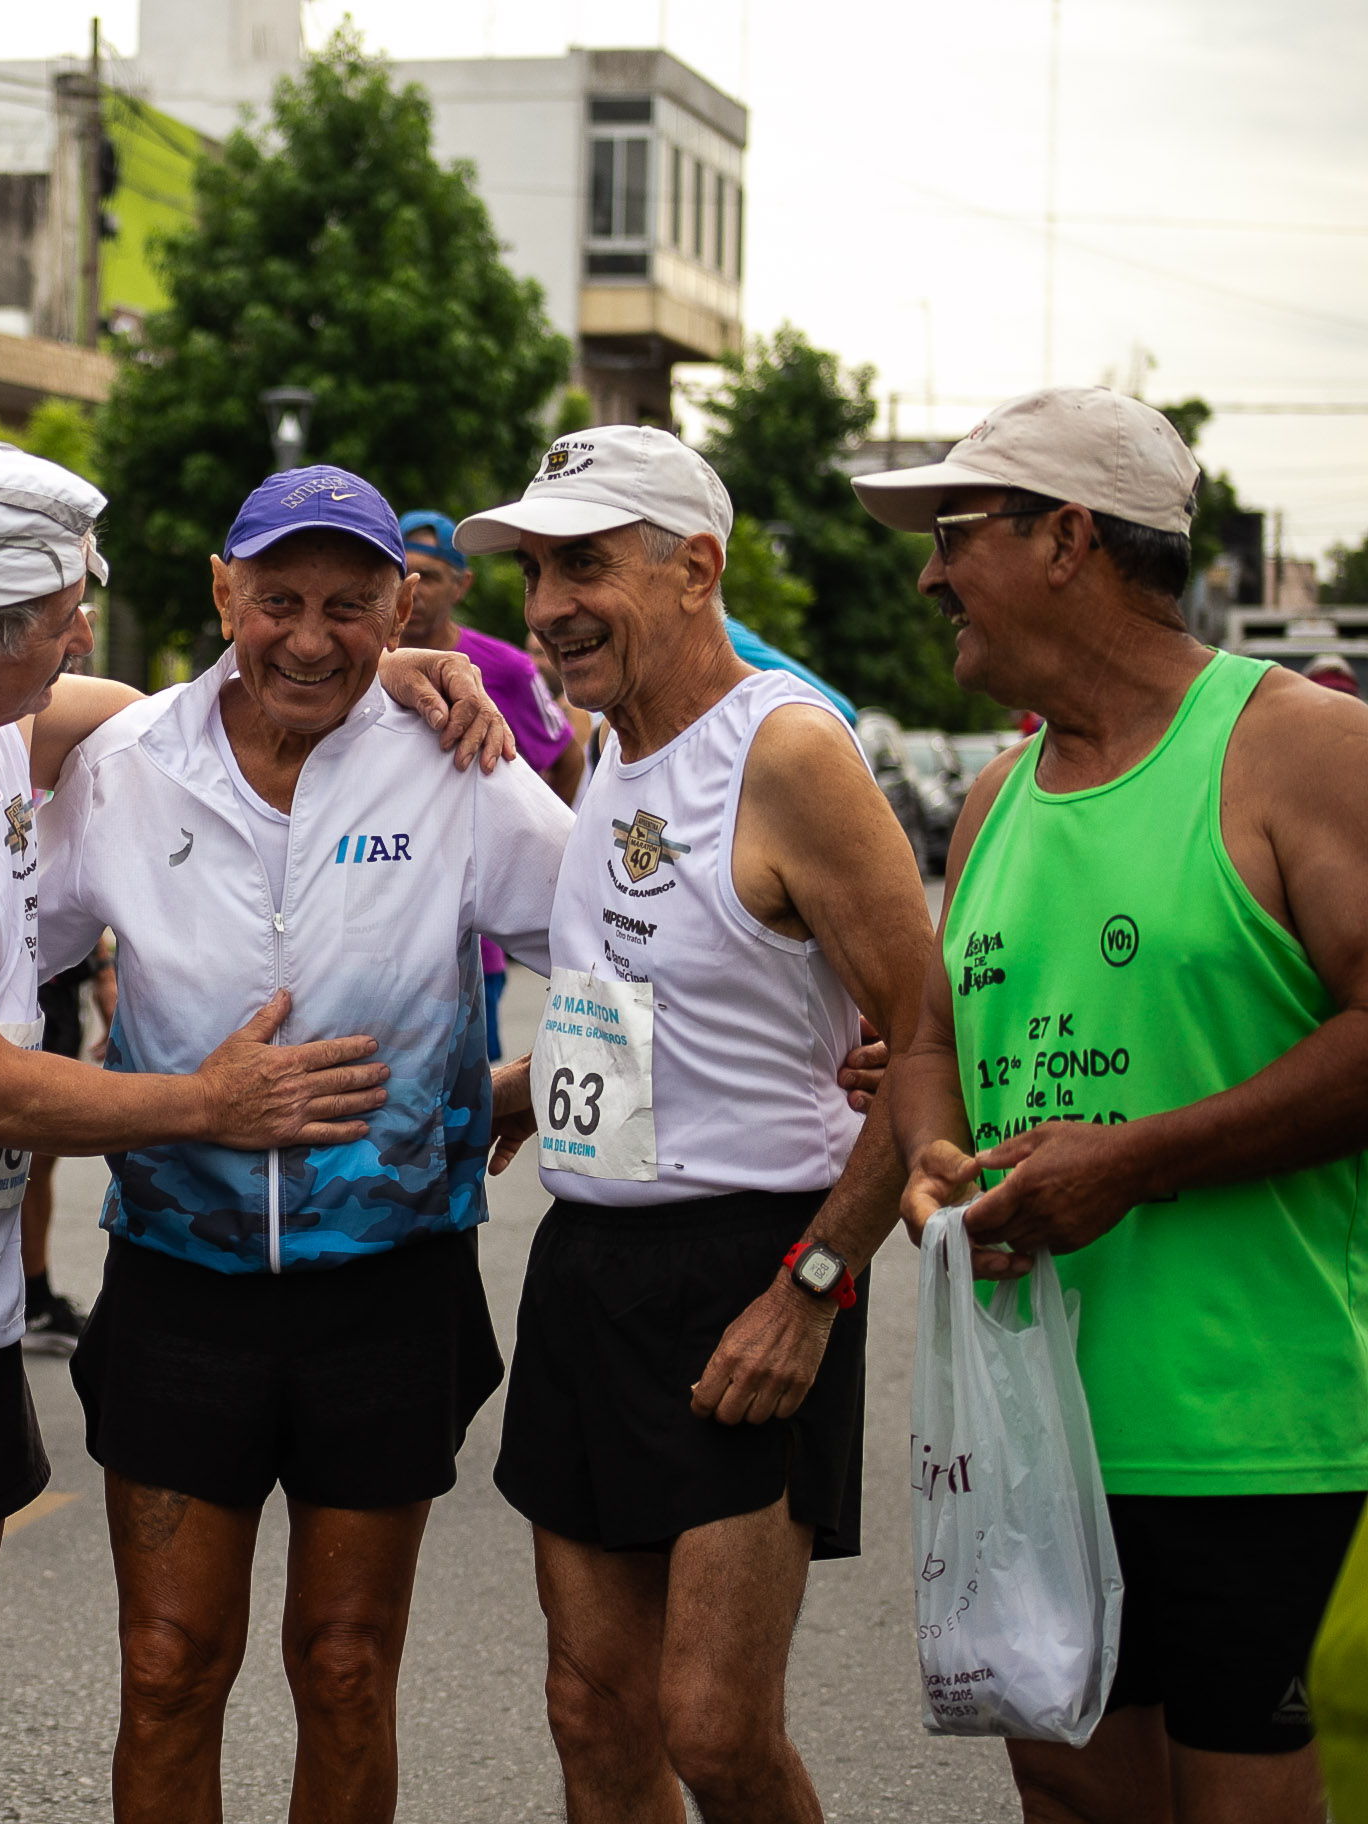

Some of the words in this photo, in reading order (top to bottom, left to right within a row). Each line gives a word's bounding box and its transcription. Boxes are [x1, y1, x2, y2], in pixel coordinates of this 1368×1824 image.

[280, 476, 349, 509] NIKE
[630, 849, 651, 870] 40
[628, 879, 676, 897] GRANEROS
[974, 955, 987, 968] DE
[552, 994, 562, 1011] 40
[1027, 1015, 1051, 1041] 27
[1058, 1013, 1074, 1037] K
[1033, 1047, 1130, 1081] FONDO
[548, 1067, 605, 1136] 63
[1025, 1084, 1047, 1108] de
[1056, 1082, 1074, 1107] la
[543, 1136, 554, 1150] DIA
[554, 1138, 567, 1153] DEL
[568, 1140, 596, 1158] VECINO
